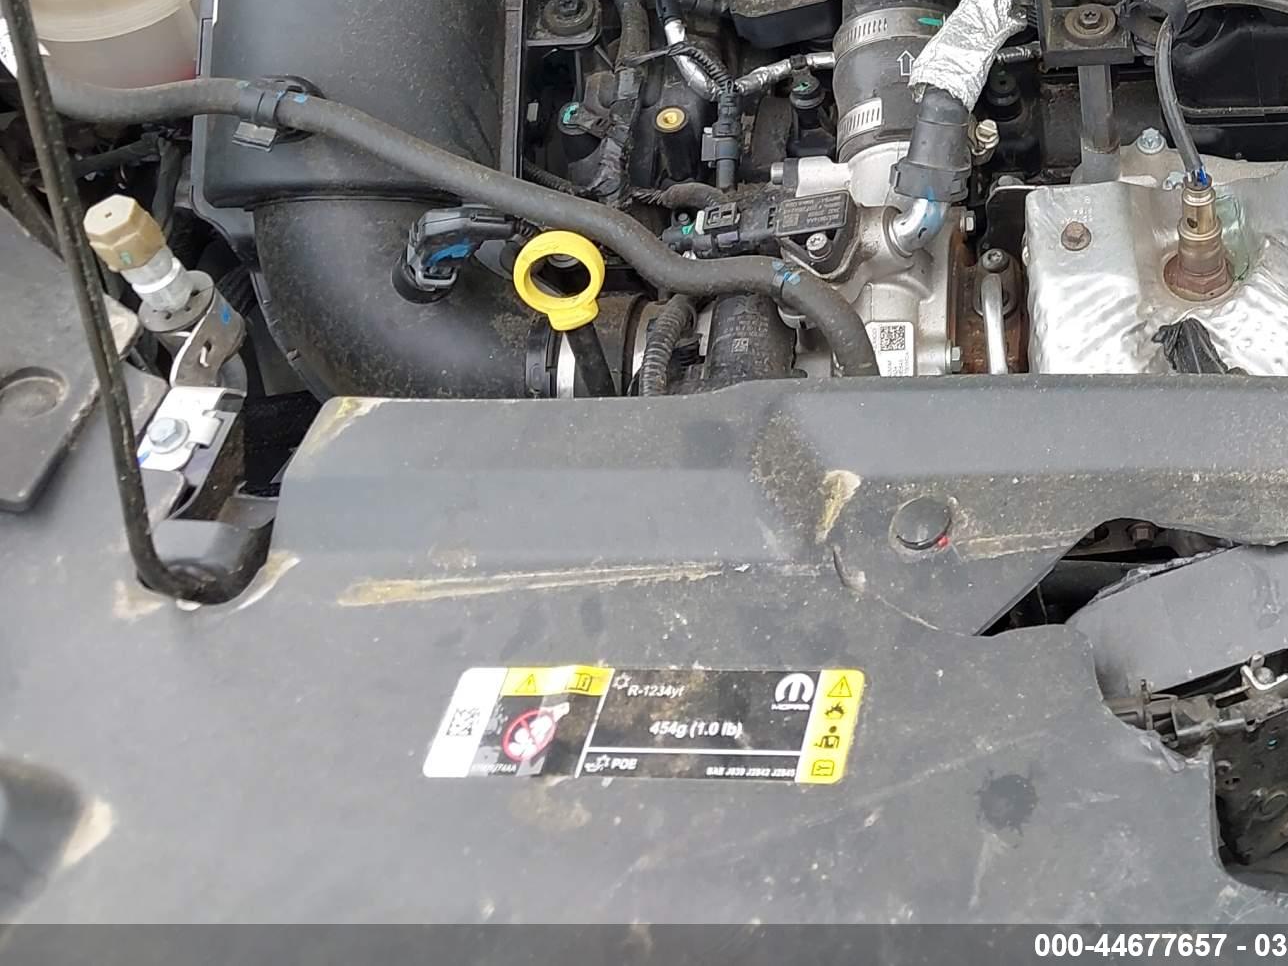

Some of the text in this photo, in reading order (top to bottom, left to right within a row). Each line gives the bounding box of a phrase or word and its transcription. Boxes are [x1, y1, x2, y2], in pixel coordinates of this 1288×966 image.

[627, 684, 686, 698] R-1234yf
[649, 719, 743, 740] 454g (1.0 lb)
